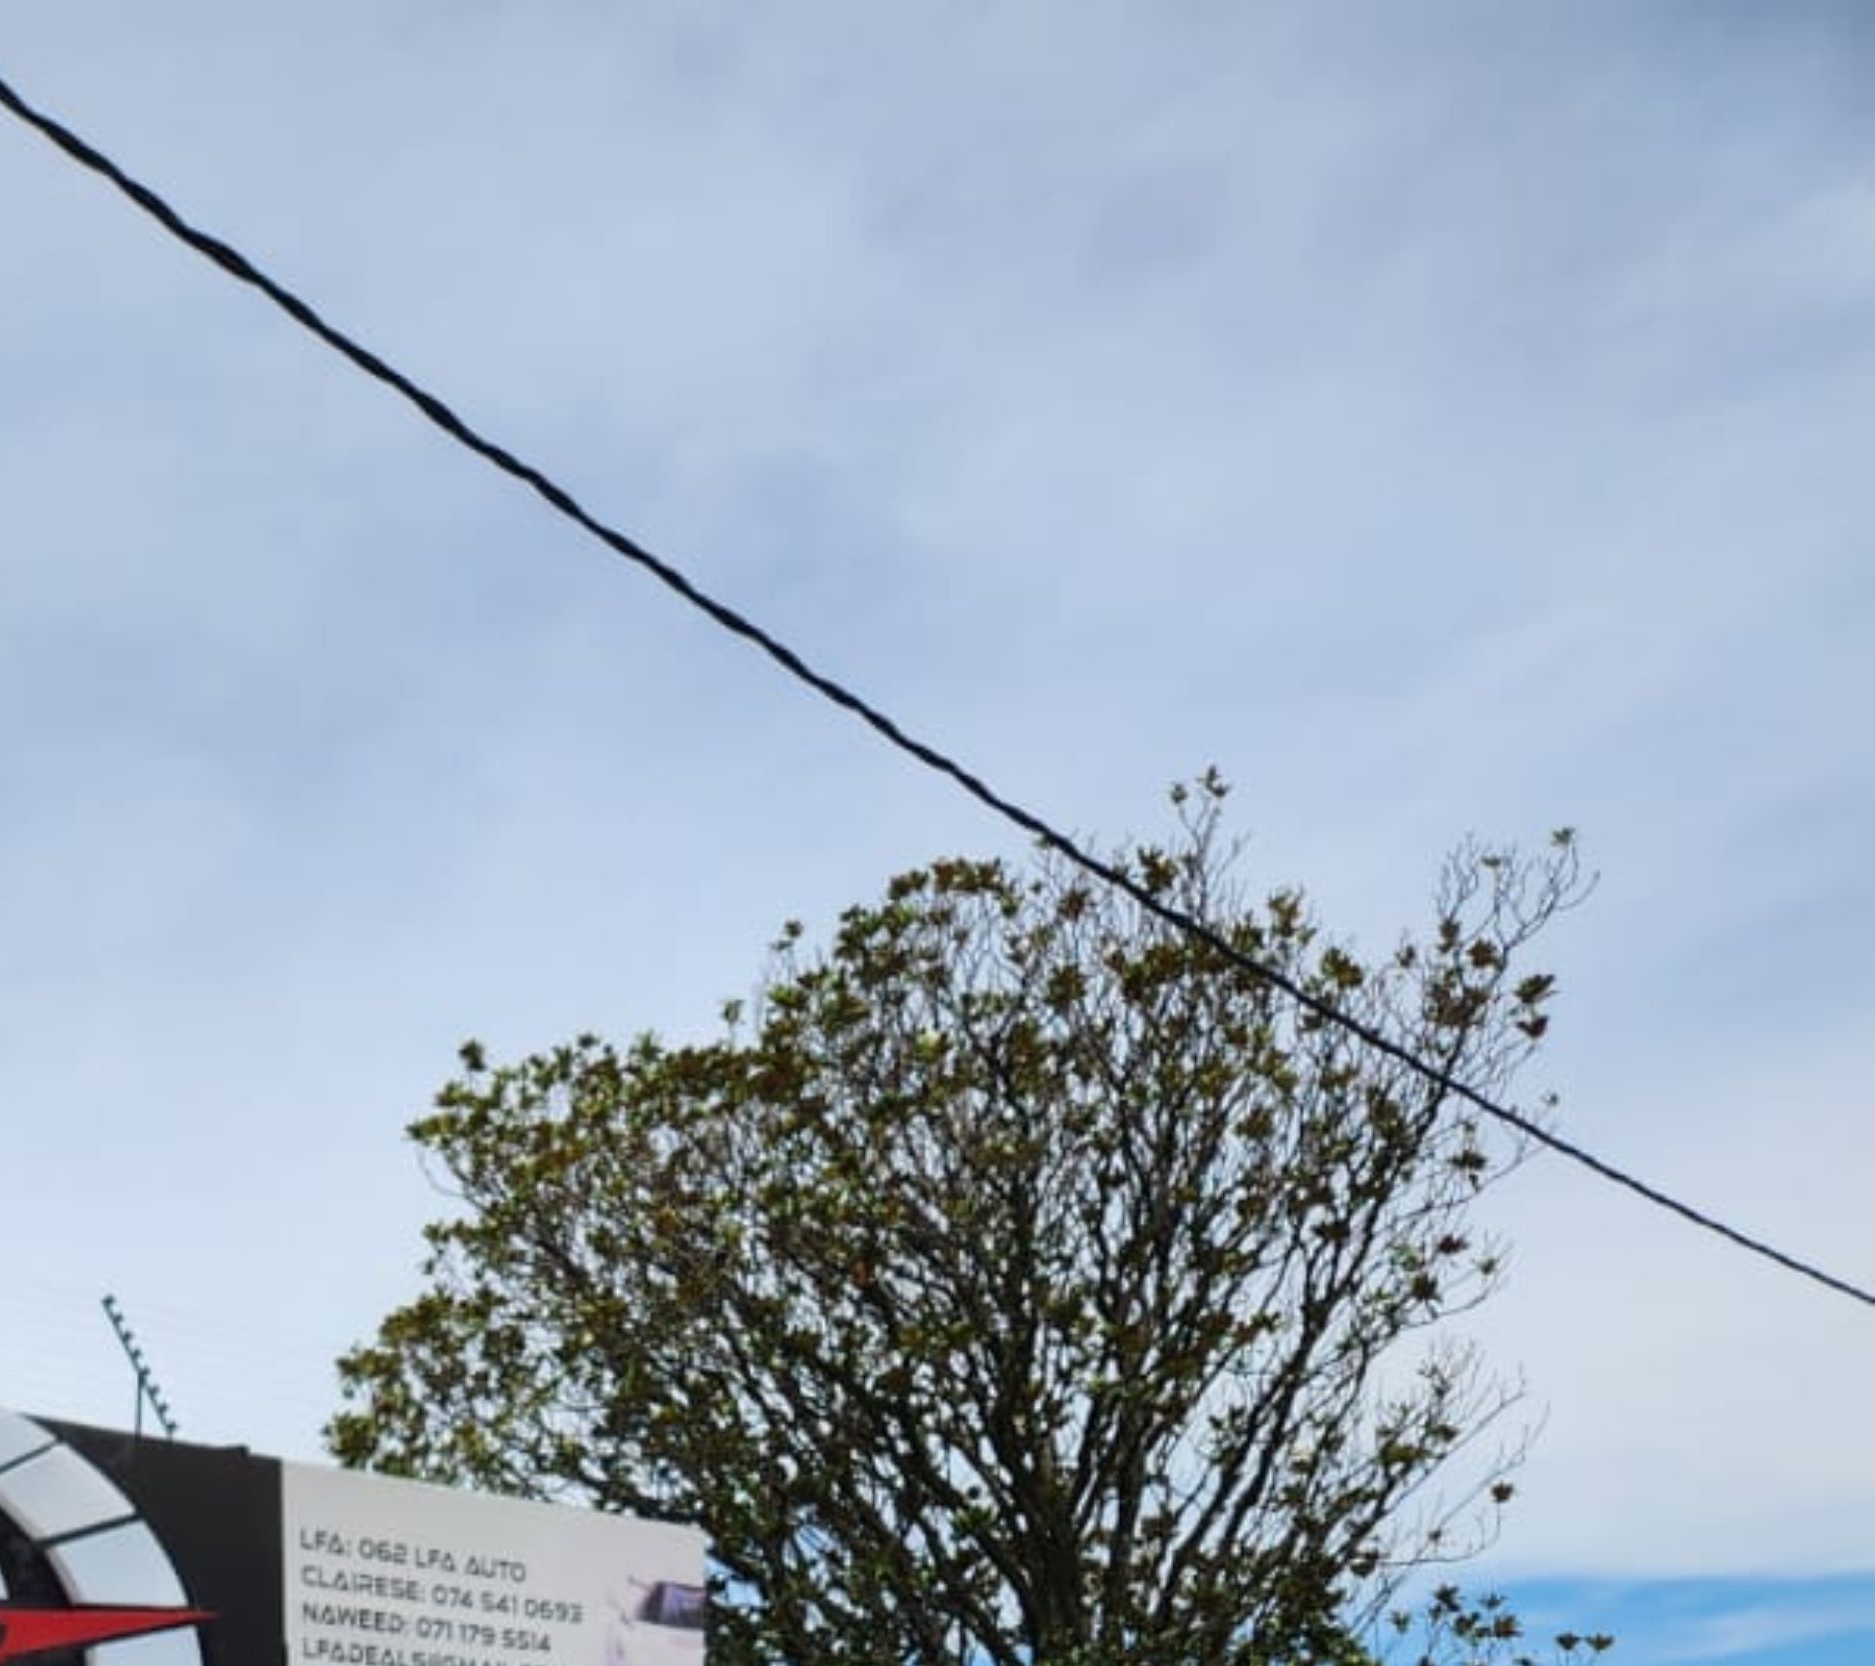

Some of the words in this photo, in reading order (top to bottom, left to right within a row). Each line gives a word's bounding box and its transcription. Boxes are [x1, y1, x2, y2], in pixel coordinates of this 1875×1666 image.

[358, 1537, 408, 1565] 062
[415, 1546, 456, 1572] LFA
[465, 1555, 527, 1583] AUTO
